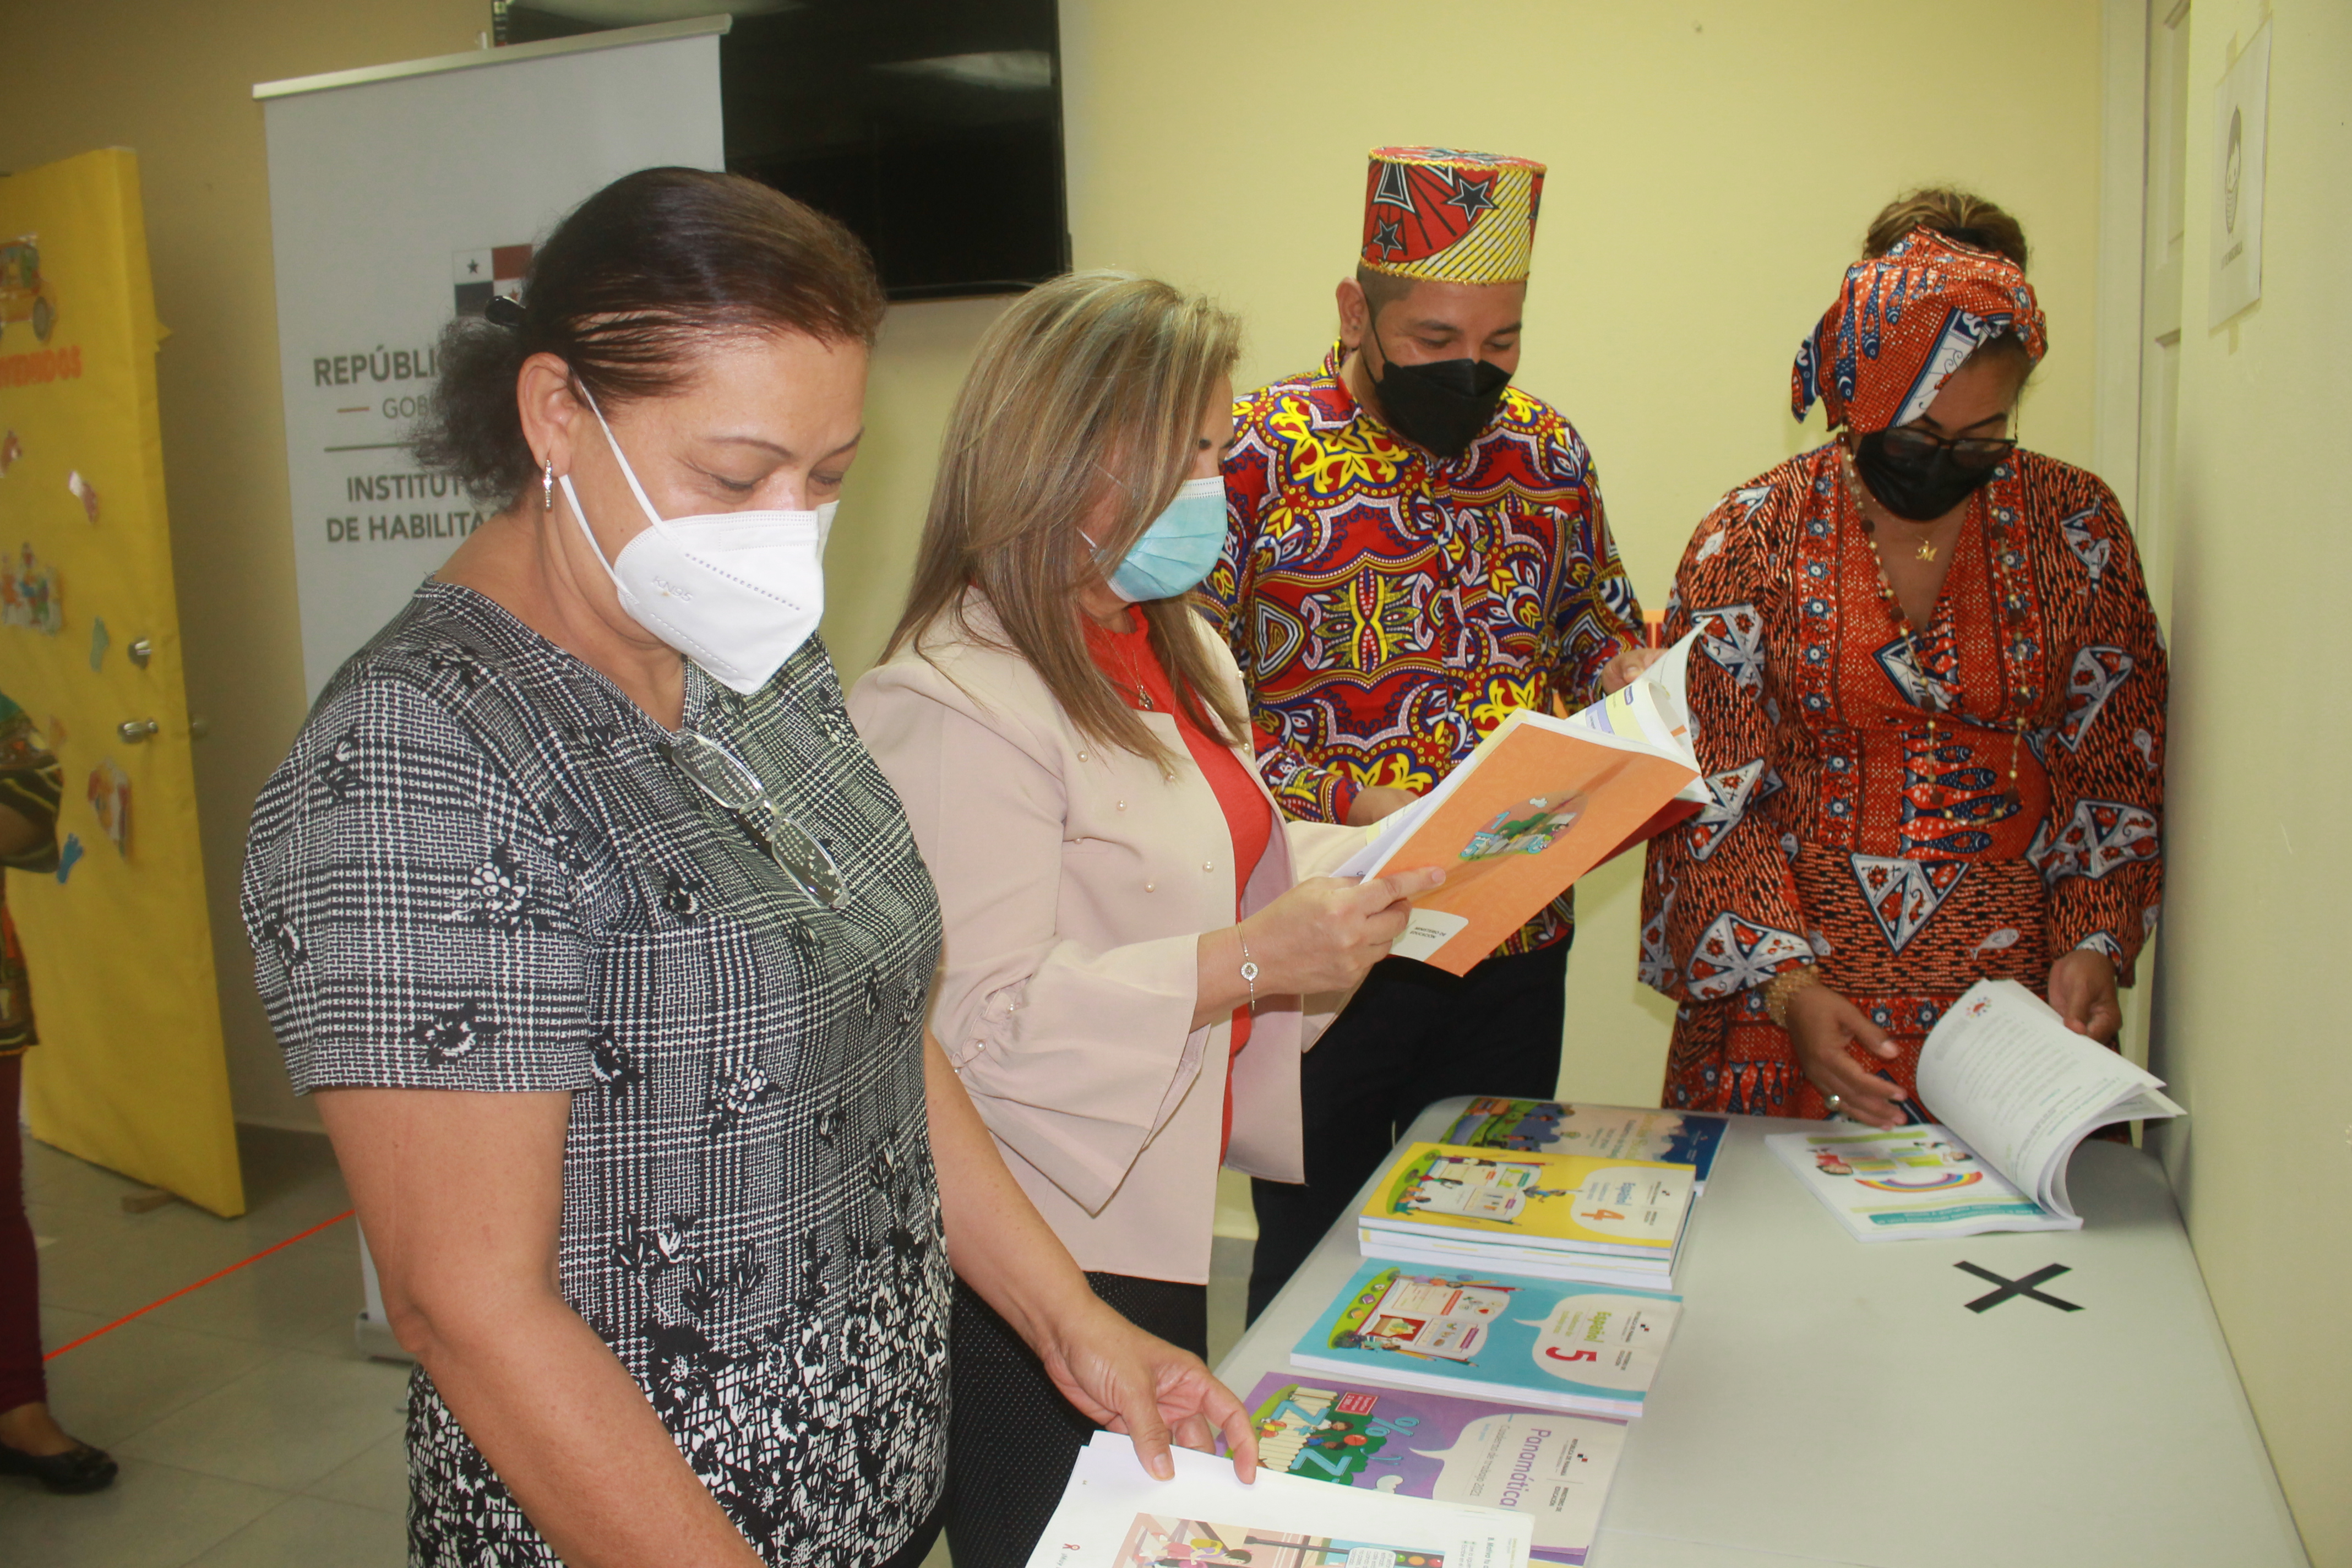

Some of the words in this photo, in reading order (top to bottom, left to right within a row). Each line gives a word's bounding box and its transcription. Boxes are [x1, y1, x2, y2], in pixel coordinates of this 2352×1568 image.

[314, 344, 439, 386] REPÚBLI
[382, 395, 429, 419] GOB
[347, 472, 467, 502] INSTITUT
[326, 518, 360, 542] DE
[368, 512, 487, 541] HABILITA
[651, 576, 693, 601] KN95
[1581, 1209, 1625, 1221] 4
[1584, 1311, 1612, 1343] Español
[1545, 1347, 1597, 1362] 5
[1490, 1425, 1510, 1451] Cuaderno
[1474, 1460, 1493, 1482] trabajo
[1499, 1428, 1551, 1507] Panamática
